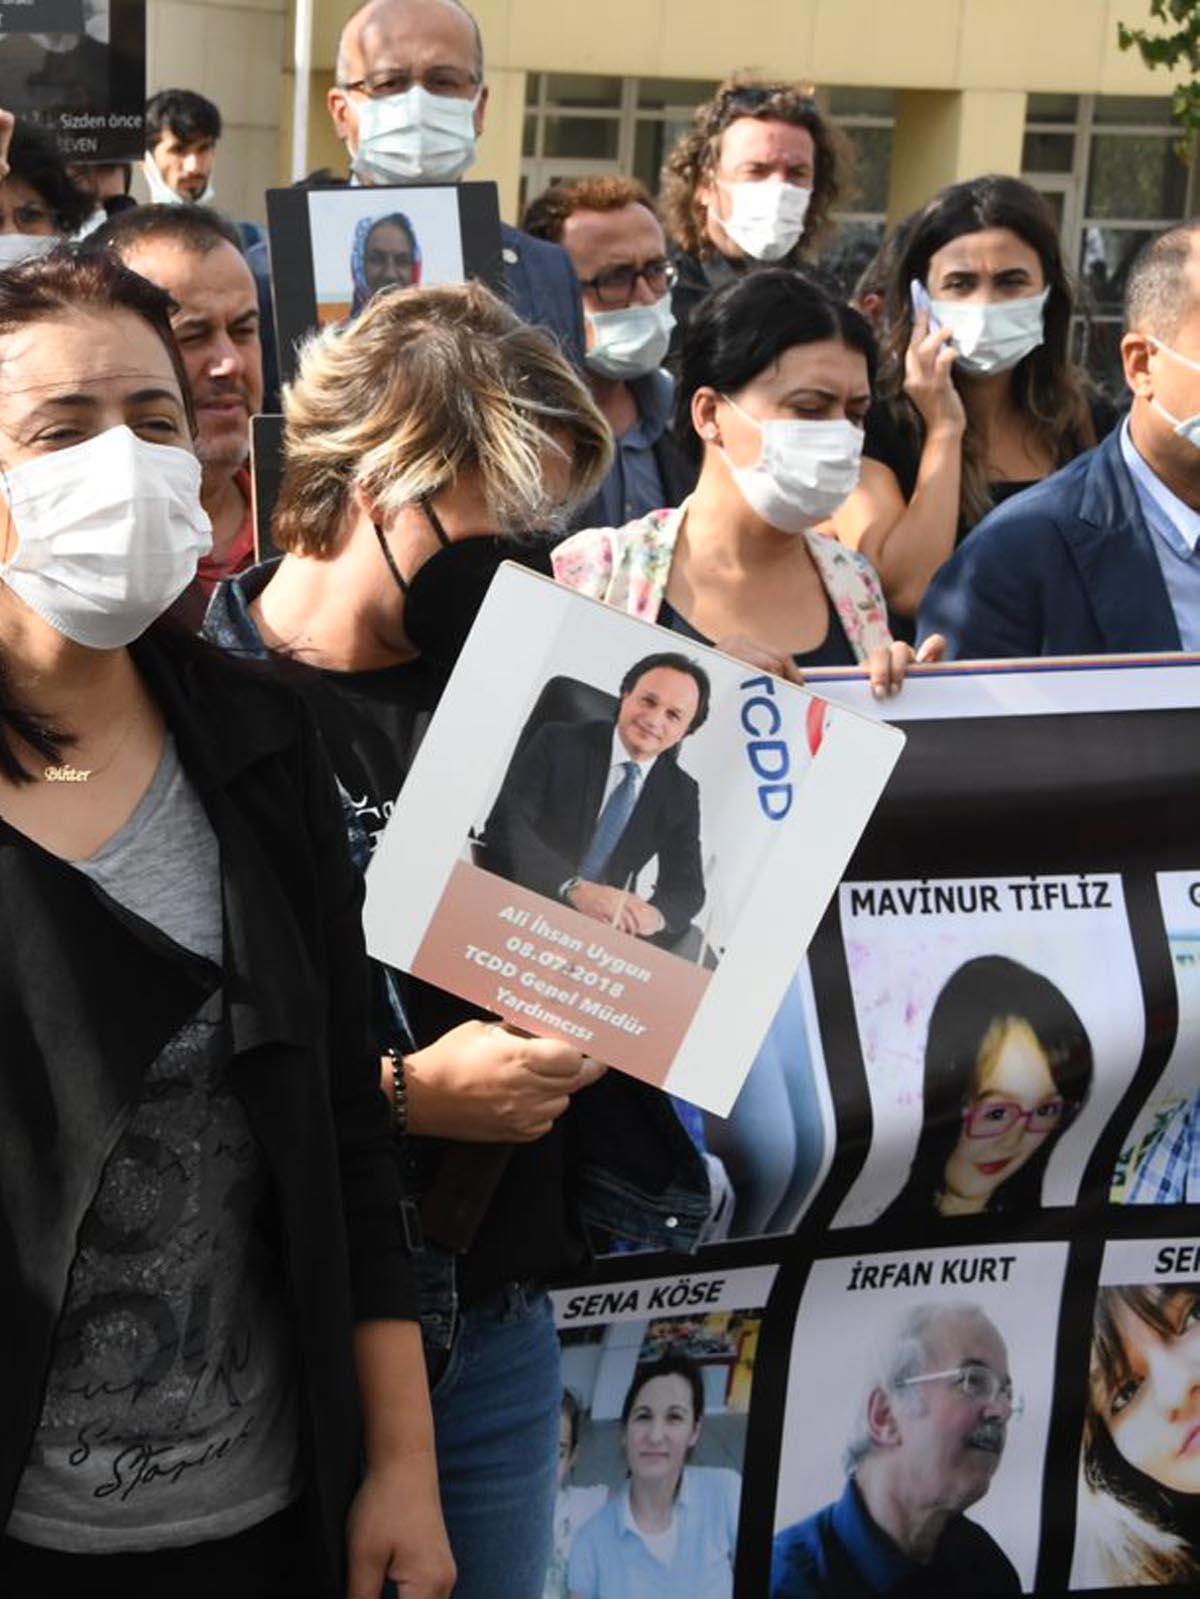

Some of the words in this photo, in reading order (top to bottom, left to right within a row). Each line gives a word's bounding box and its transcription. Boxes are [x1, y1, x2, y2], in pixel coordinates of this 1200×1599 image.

[60, 113, 105, 128] Sizden
[108, 113, 143, 128] önce
[851, 878, 1001, 917] MAVİNUR
[1008, 873, 1112, 912] TİFLİZ
[498, 905, 531, 927] Ali
[530, 914, 583, 952] İhsan
[587, 943, 652, 983] Uygun
[506, 936, 625, 998] 08.07.2018
[465, 944, 518, 978] TCDD
[520, 971, 580, 1007] Genel
[578, 998, 648, 1037] Müdür
[496, 986, 595, 1042] Yardımcısı
[563, 1290, 639, 1319] SENA
[648, 1278, 726, 1310] KÖSE
[846, 1260, 933, 1291] İRFAN
[941, 1256, 1017, 1285] KURT
